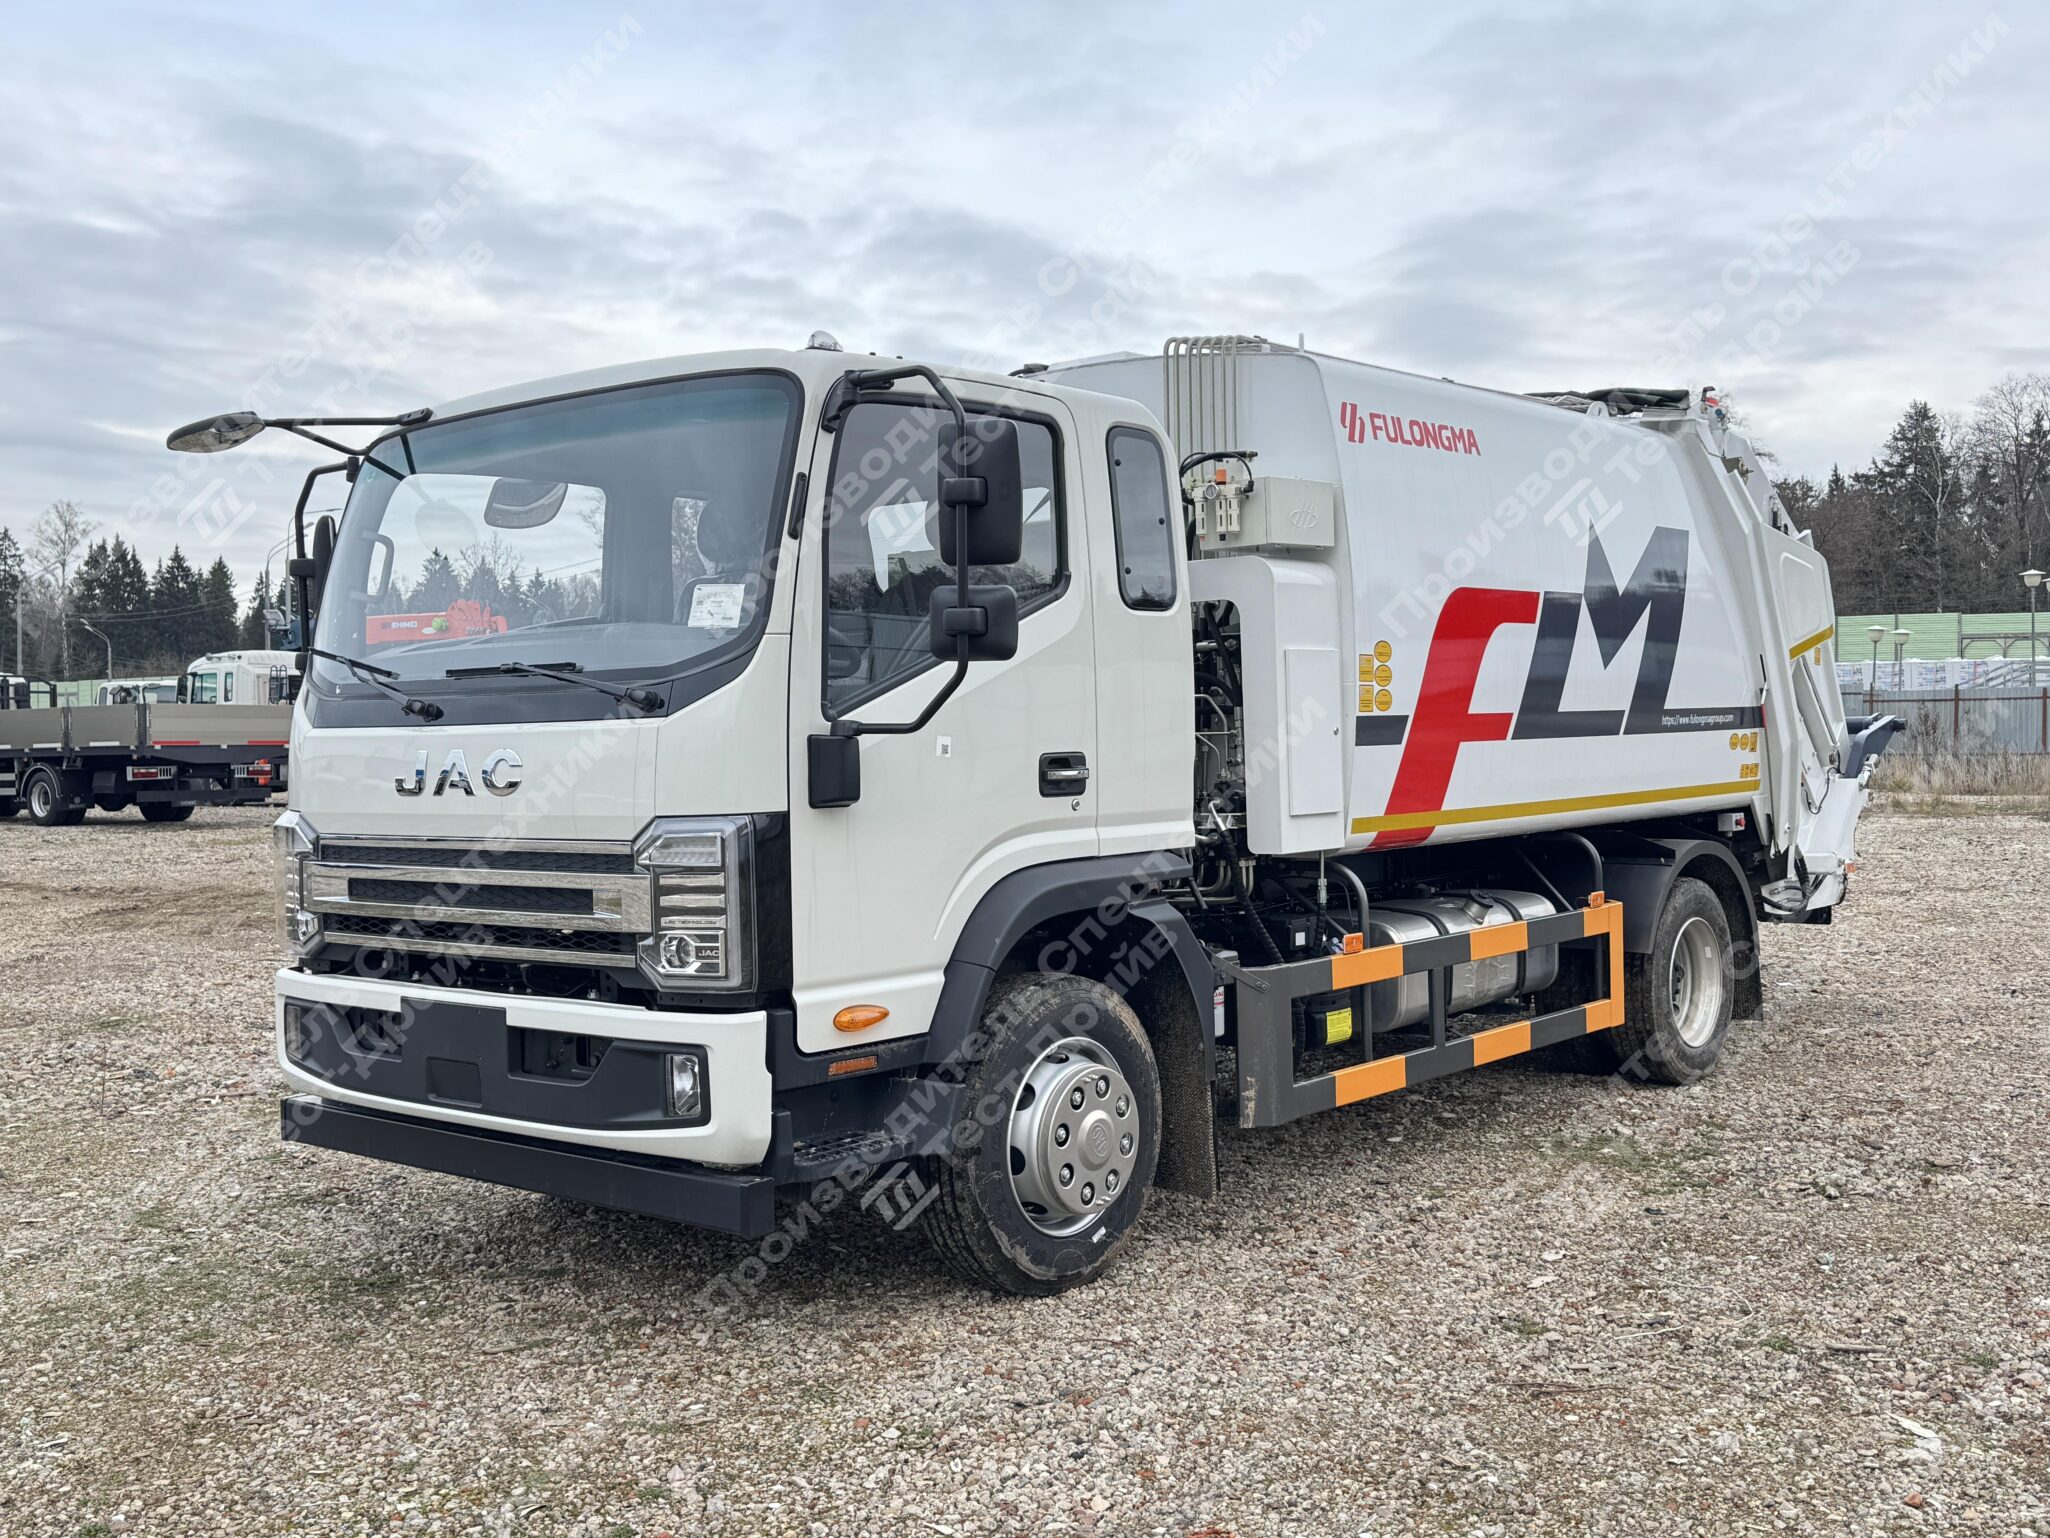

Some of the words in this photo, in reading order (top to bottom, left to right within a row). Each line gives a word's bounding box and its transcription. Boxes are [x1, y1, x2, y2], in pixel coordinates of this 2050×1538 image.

[1369, 412, 1482, 456] FULONGMA
[1661, 713, 1734, 728] https://www.fulongmagroup.com
[394, 747, 523, 797] JAC
[698, 949, 720, 957] JAC
